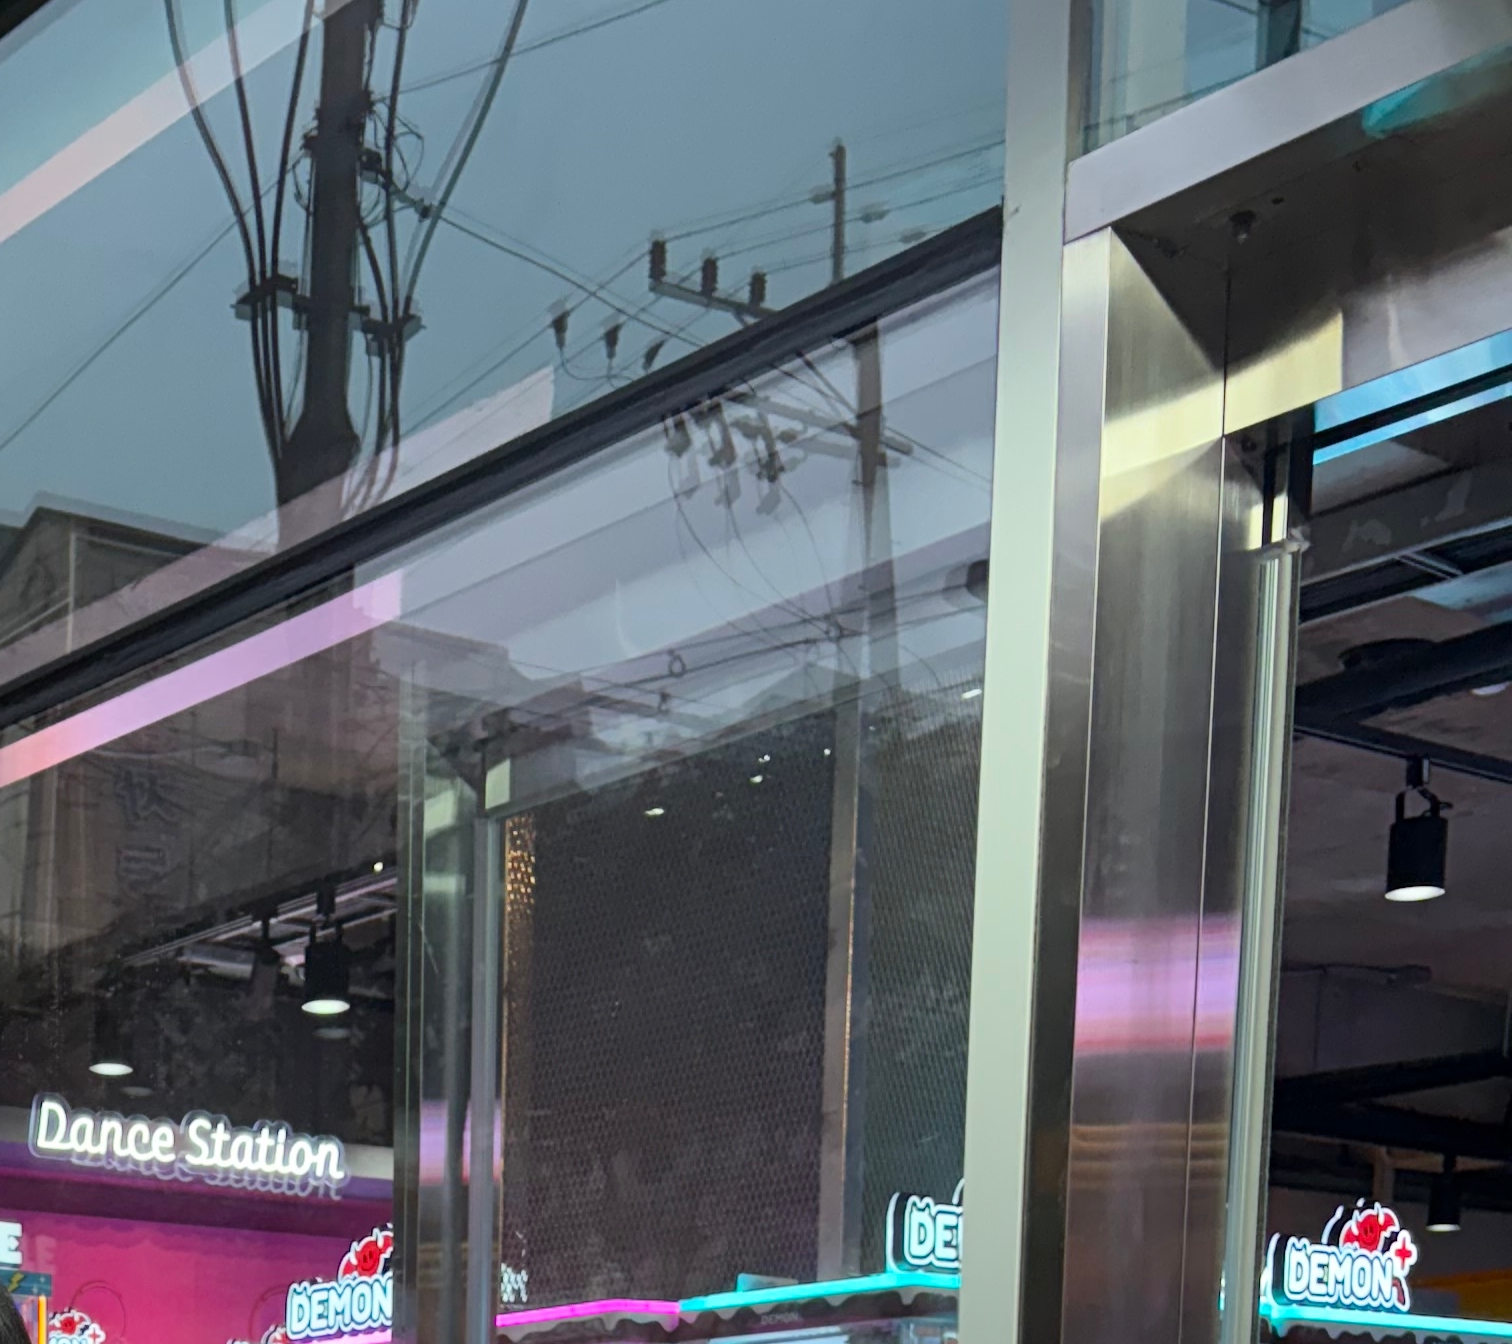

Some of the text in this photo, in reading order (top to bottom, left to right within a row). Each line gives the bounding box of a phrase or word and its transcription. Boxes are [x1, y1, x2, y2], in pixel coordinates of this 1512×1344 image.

[37, 1100, 345, 1180] Dance Station
[1288, 1246, 1394, 1301] DEMON
[288, 1277, 393, 1332] DEMON
